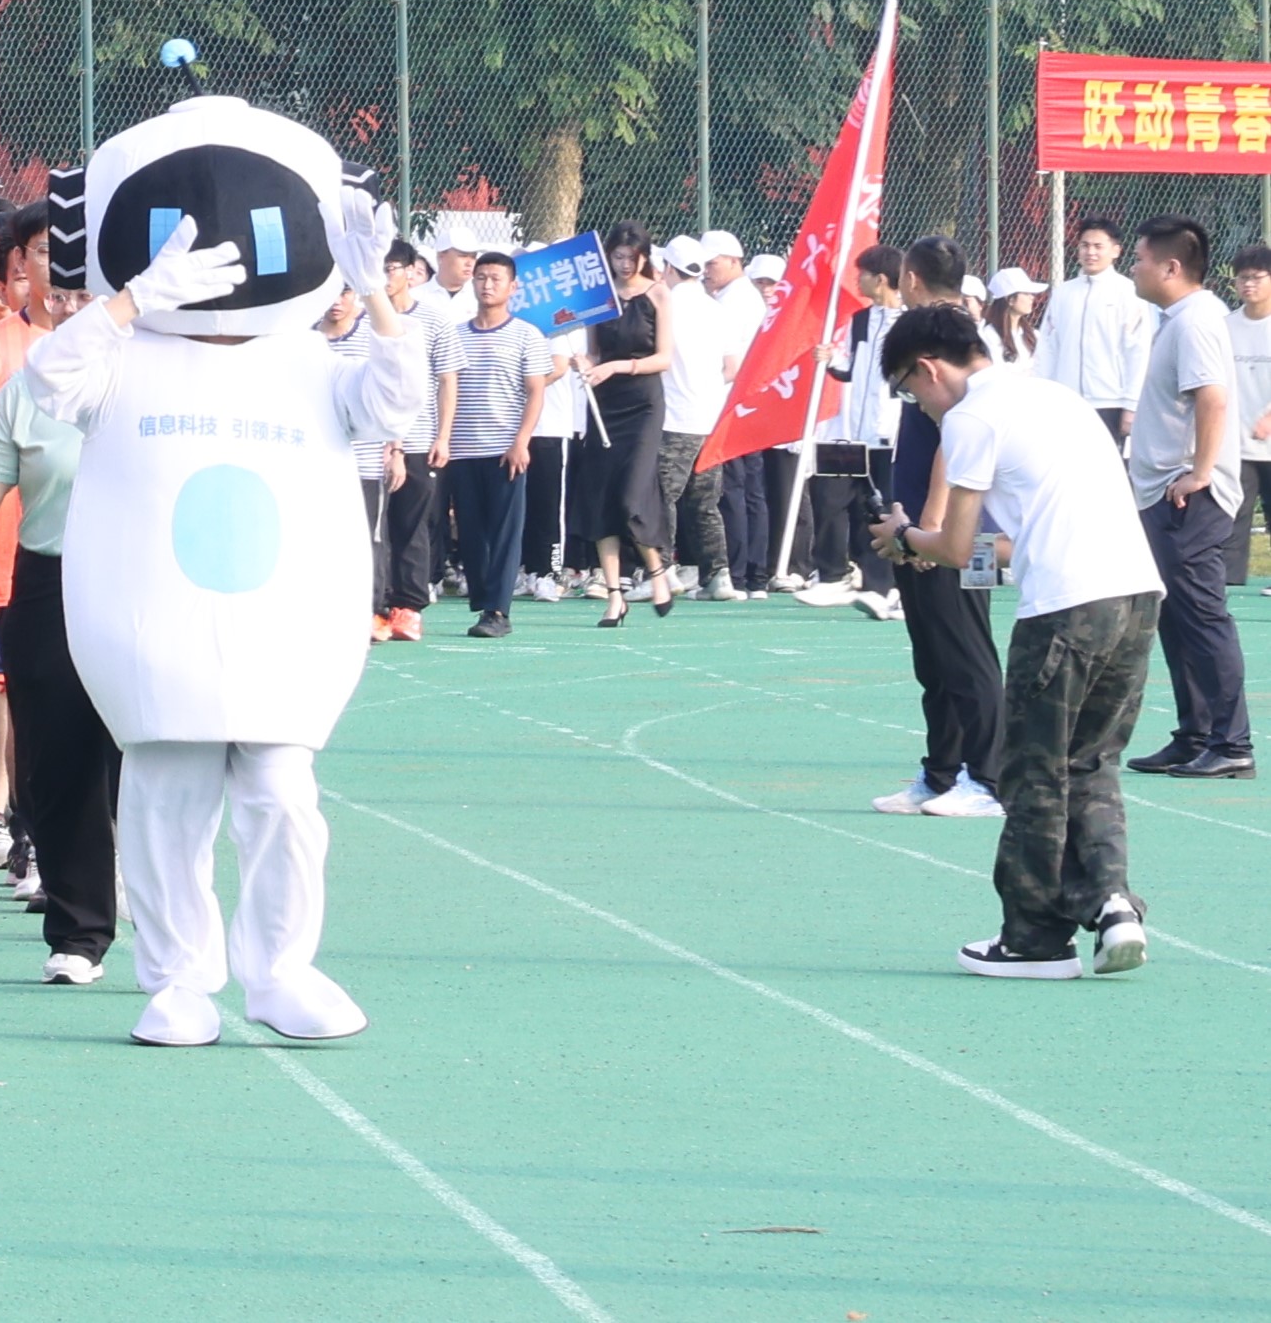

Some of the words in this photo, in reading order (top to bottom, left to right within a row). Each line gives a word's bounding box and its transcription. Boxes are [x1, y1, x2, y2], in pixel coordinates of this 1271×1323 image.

[1081, 79, 1271, 154] 跃动青春
[138, 413, 218, 438] 信息科技
[231, 417, 307, 449] 引领未来
